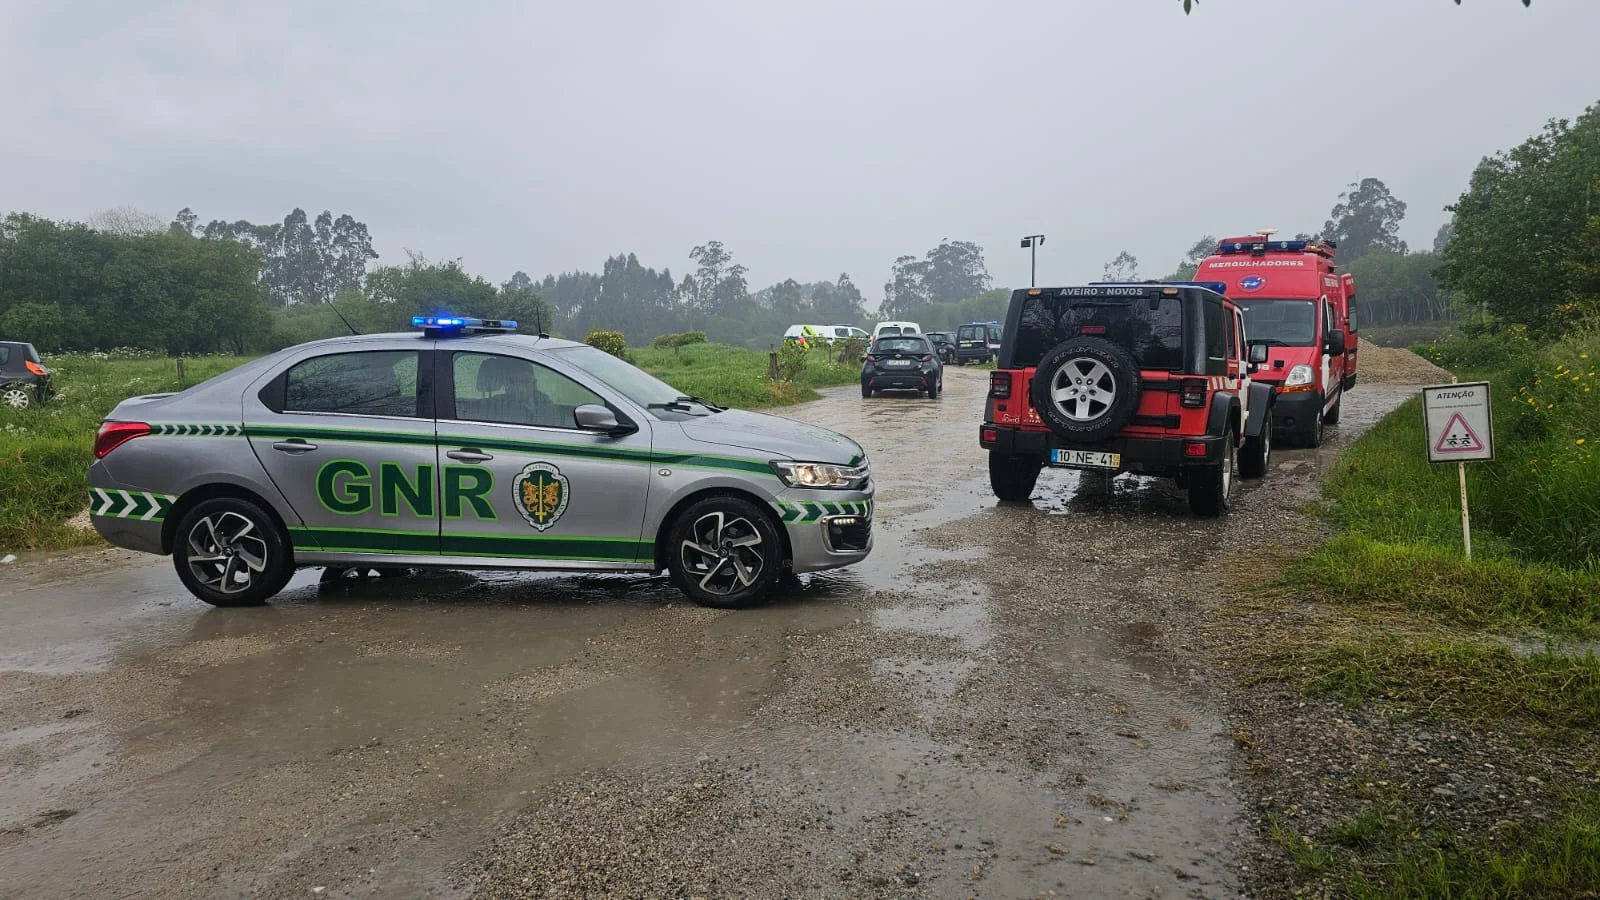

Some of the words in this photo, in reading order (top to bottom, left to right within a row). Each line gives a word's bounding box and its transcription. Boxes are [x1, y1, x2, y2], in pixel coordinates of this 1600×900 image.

[1208, 260, 1304, 269] MERGULHADORES
[1060, 288, 1098, 296] AVEIRO
[1106, 288, 1143, 296] NOVOS
[1436, 390, 1475, 400] ATENÇÃO
[315, 458, 499, 521] GNR
